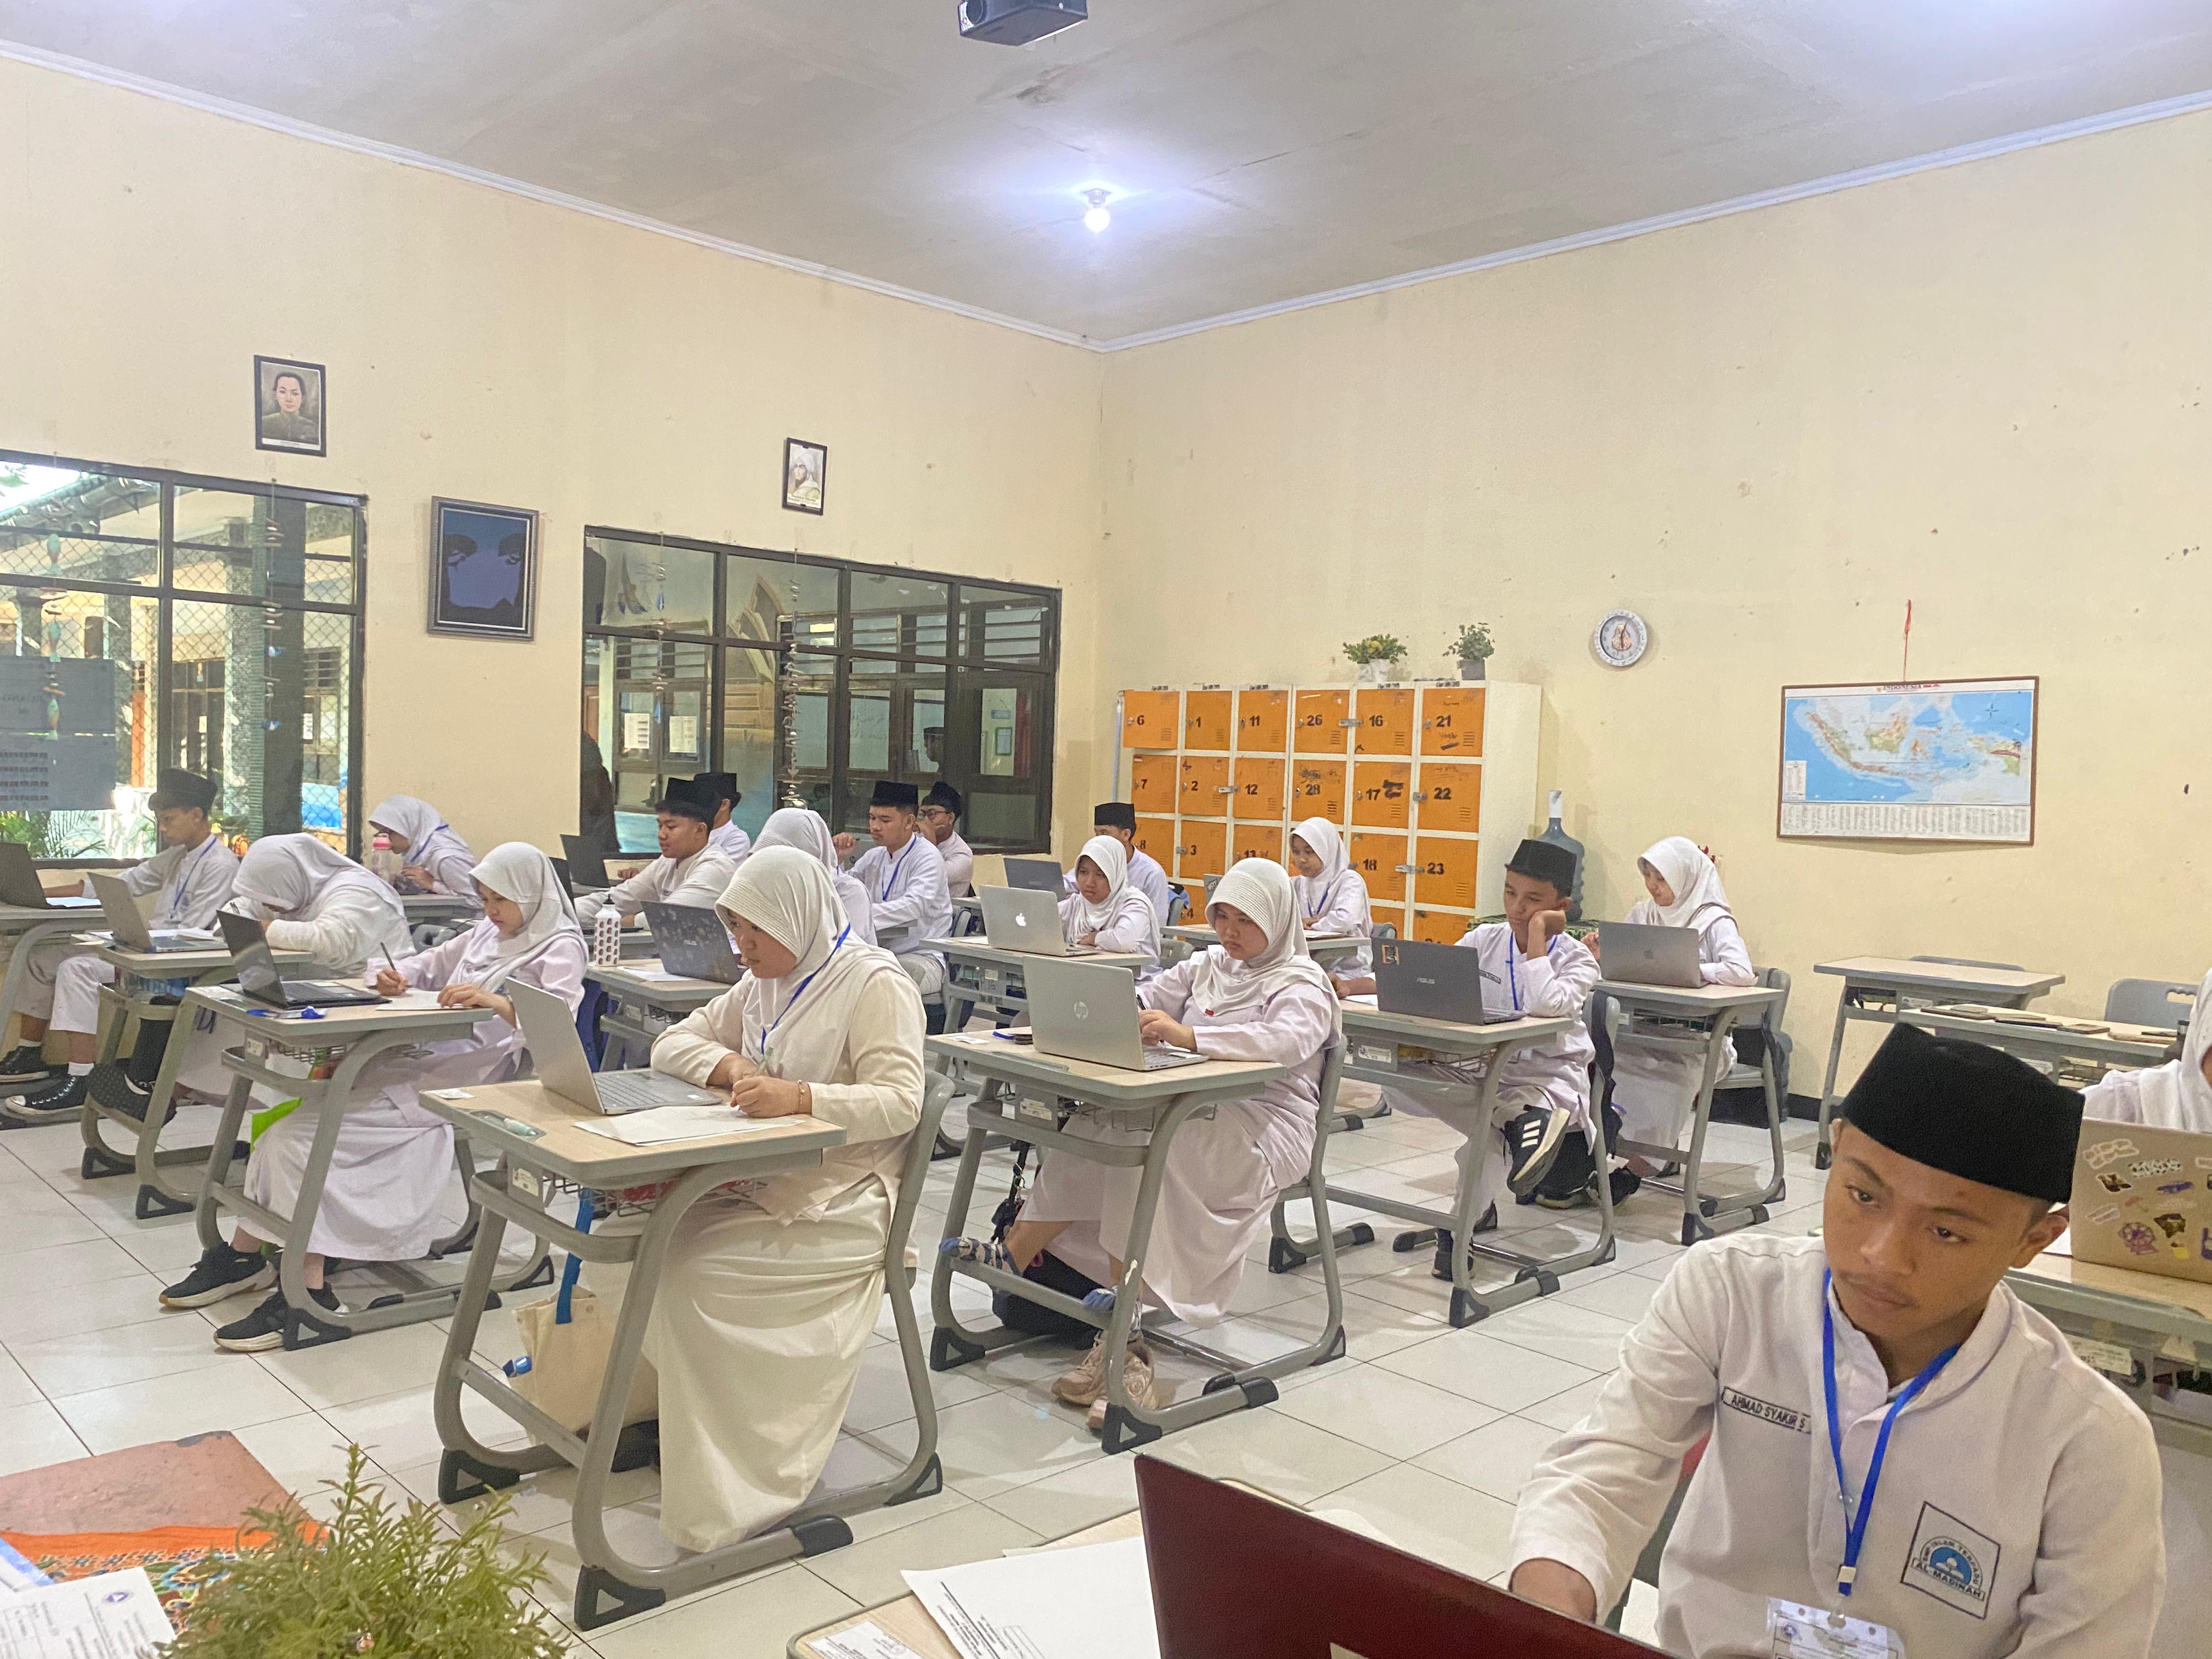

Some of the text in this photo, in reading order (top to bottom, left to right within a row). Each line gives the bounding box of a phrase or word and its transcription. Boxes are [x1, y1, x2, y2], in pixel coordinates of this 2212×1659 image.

[1137, 715, 1144, 725] 6
[1196, 716, 1201, 728] 1
[1250, 715, 1260, 727] 11
[1306, 714, 1323, 726] 26
[1369, 715, 1383, 727] 16
[1436, 715, 1452, 727] 21
[1141, 779, 1148, 789] 7
[1191, 781, 1198, 791] 2
[1245, 784, 1258, 794] 12
[1366, 789, 1380, 800] 17
[1434, 787, 1451, 800] 22
[1140, 839, 1146, 849] 8
[1190, 845, 1197, 855] 3
[1363, 858, 1378, 871] 18
[1427, 862, 1444, 874] 23
[1731, 1394, 1805, 1429] AHMAD SYAKIR S
